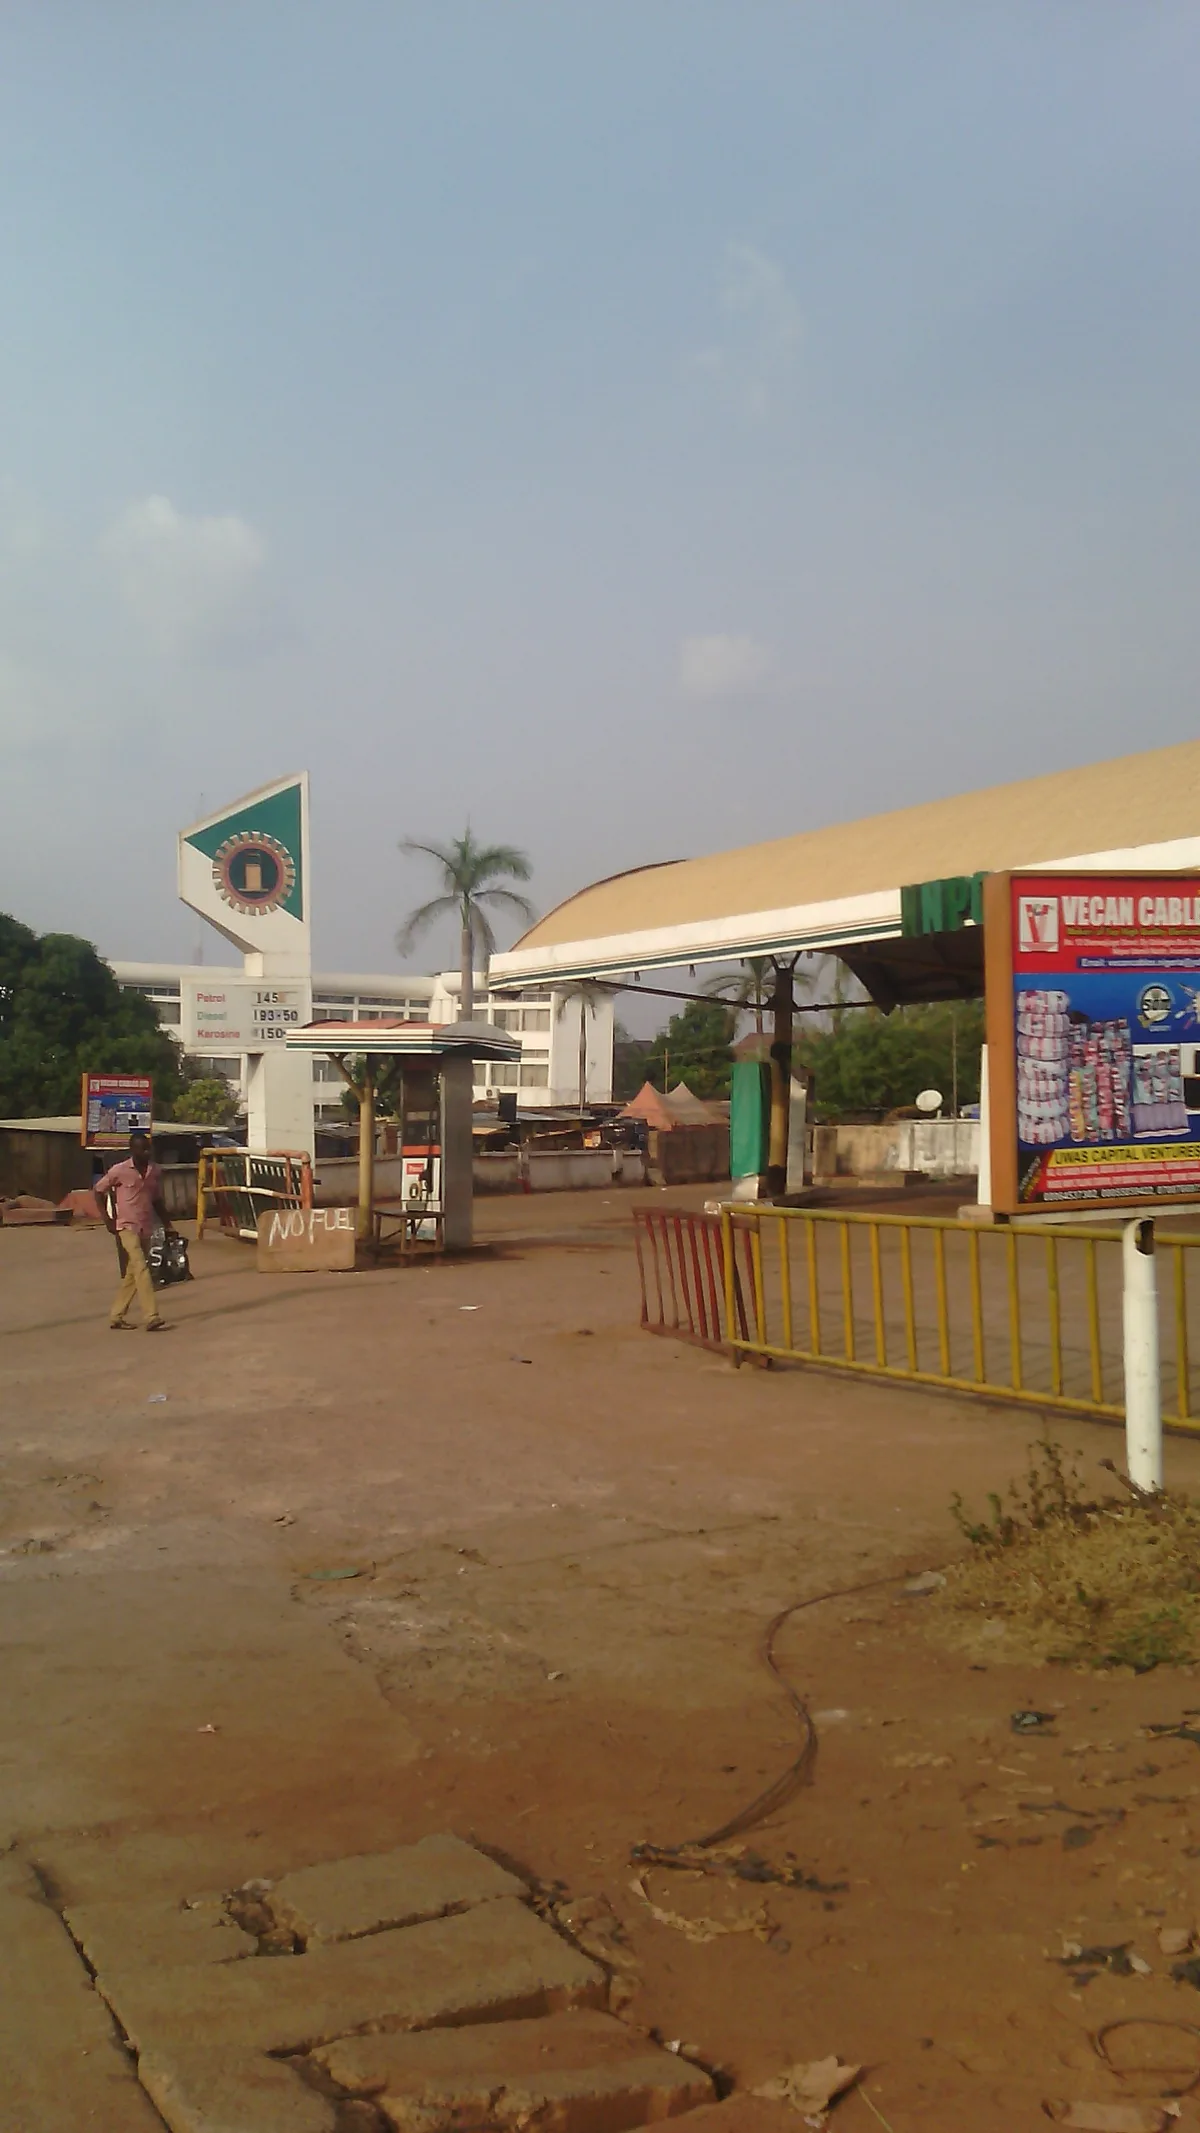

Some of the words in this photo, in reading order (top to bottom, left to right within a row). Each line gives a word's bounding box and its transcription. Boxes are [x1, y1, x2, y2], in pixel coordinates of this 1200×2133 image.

[1061, 896, 1134, 926] VECAN
[197, 992, 226, 1002] Petrol
[256, 992, 279, 1004] 145
[1055, 1150, 1088, 1165] UWAS
[1091, 1147, 1139, 1162] CAPITAL
[1142, 1143, 1200, 1160] VENTURES
[268, 1210, 305, 1247] NO
[309, 1208, 355, 1244] FUEL
